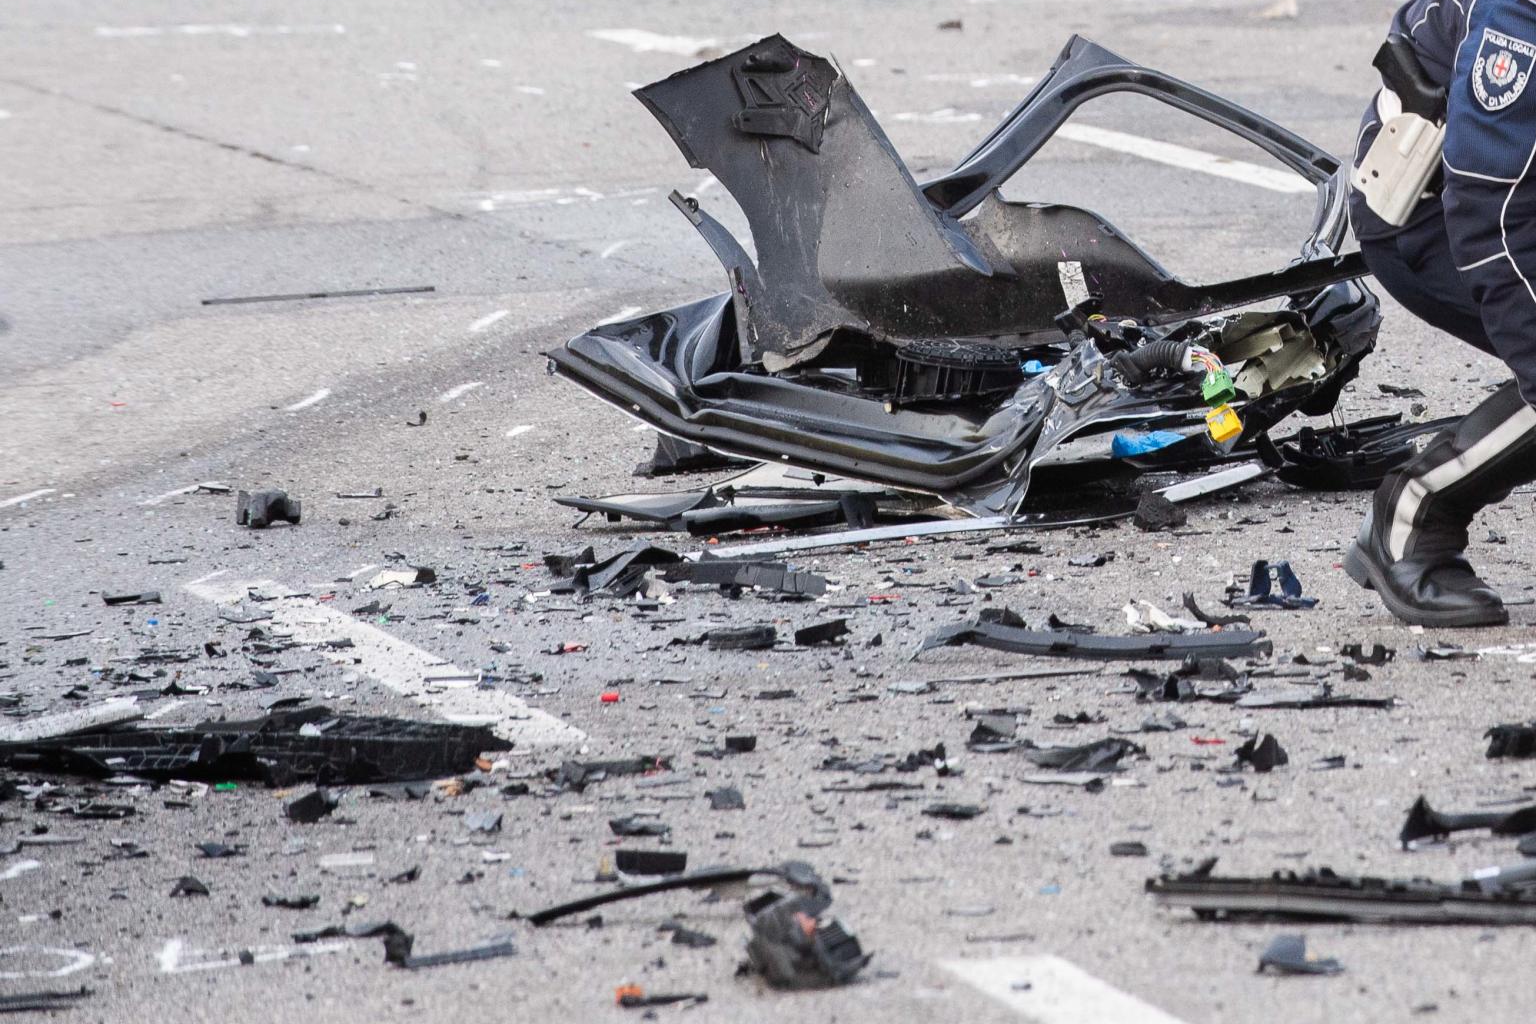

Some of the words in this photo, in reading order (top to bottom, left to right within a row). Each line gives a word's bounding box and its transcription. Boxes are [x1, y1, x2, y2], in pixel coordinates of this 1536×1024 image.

[1485, 33, 1508, 48] POLIZIA
[1508, 40, 1535, 57] LOCALE
[1488, 96, 1498, 106] DI
[1499, 71, 1526, 104] MILANO
